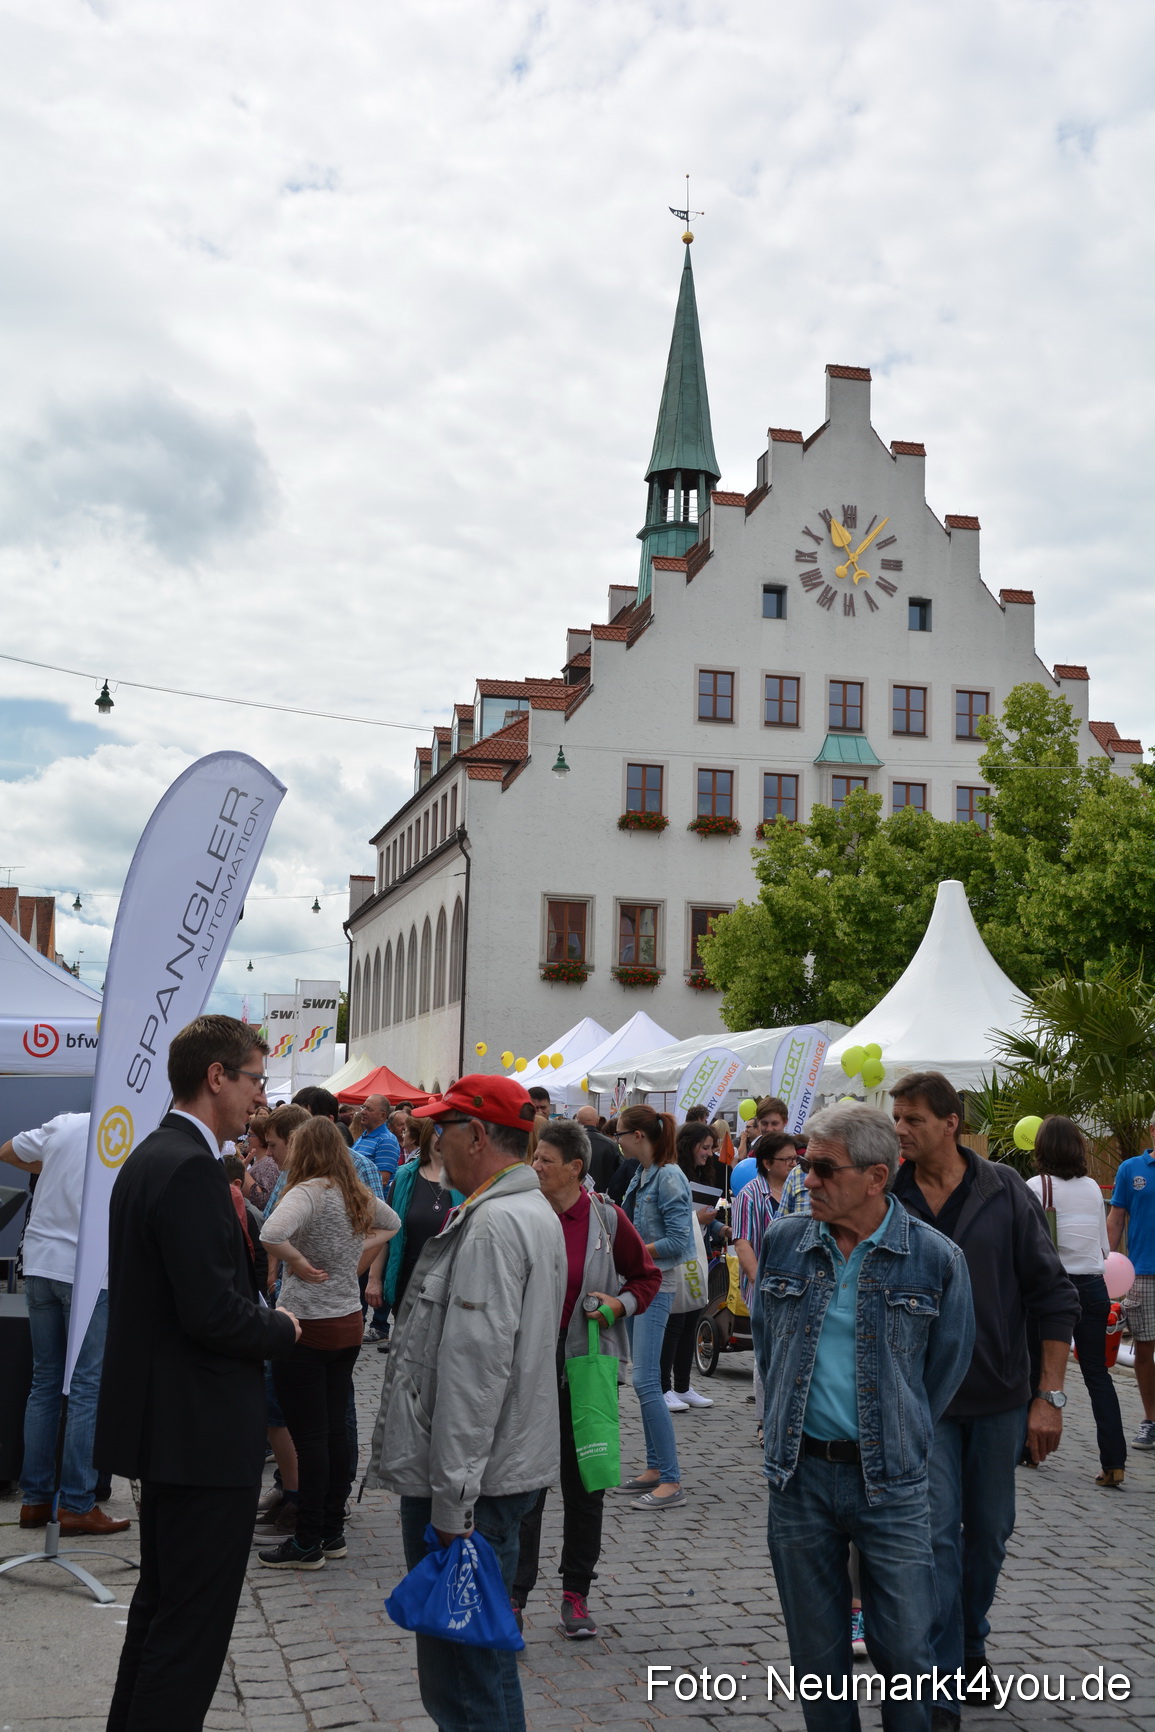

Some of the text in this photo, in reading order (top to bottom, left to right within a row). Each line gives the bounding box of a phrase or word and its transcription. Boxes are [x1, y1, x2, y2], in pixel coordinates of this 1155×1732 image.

[198, 797, 264, 972] AUTOMATION
[126, 786, 248, 1094] SPANGLER
[302, 998, 337, 1009] swn
[66, 1034, 98, 1048] bfw
[679, 1056, 719, 1111] BOCK
[714, 1062, 739, 1097] LOUNGE
[793, 1040, 826, 1134] DUSTRY LOUNGE
[684, 1260, 702, 1298] adid
